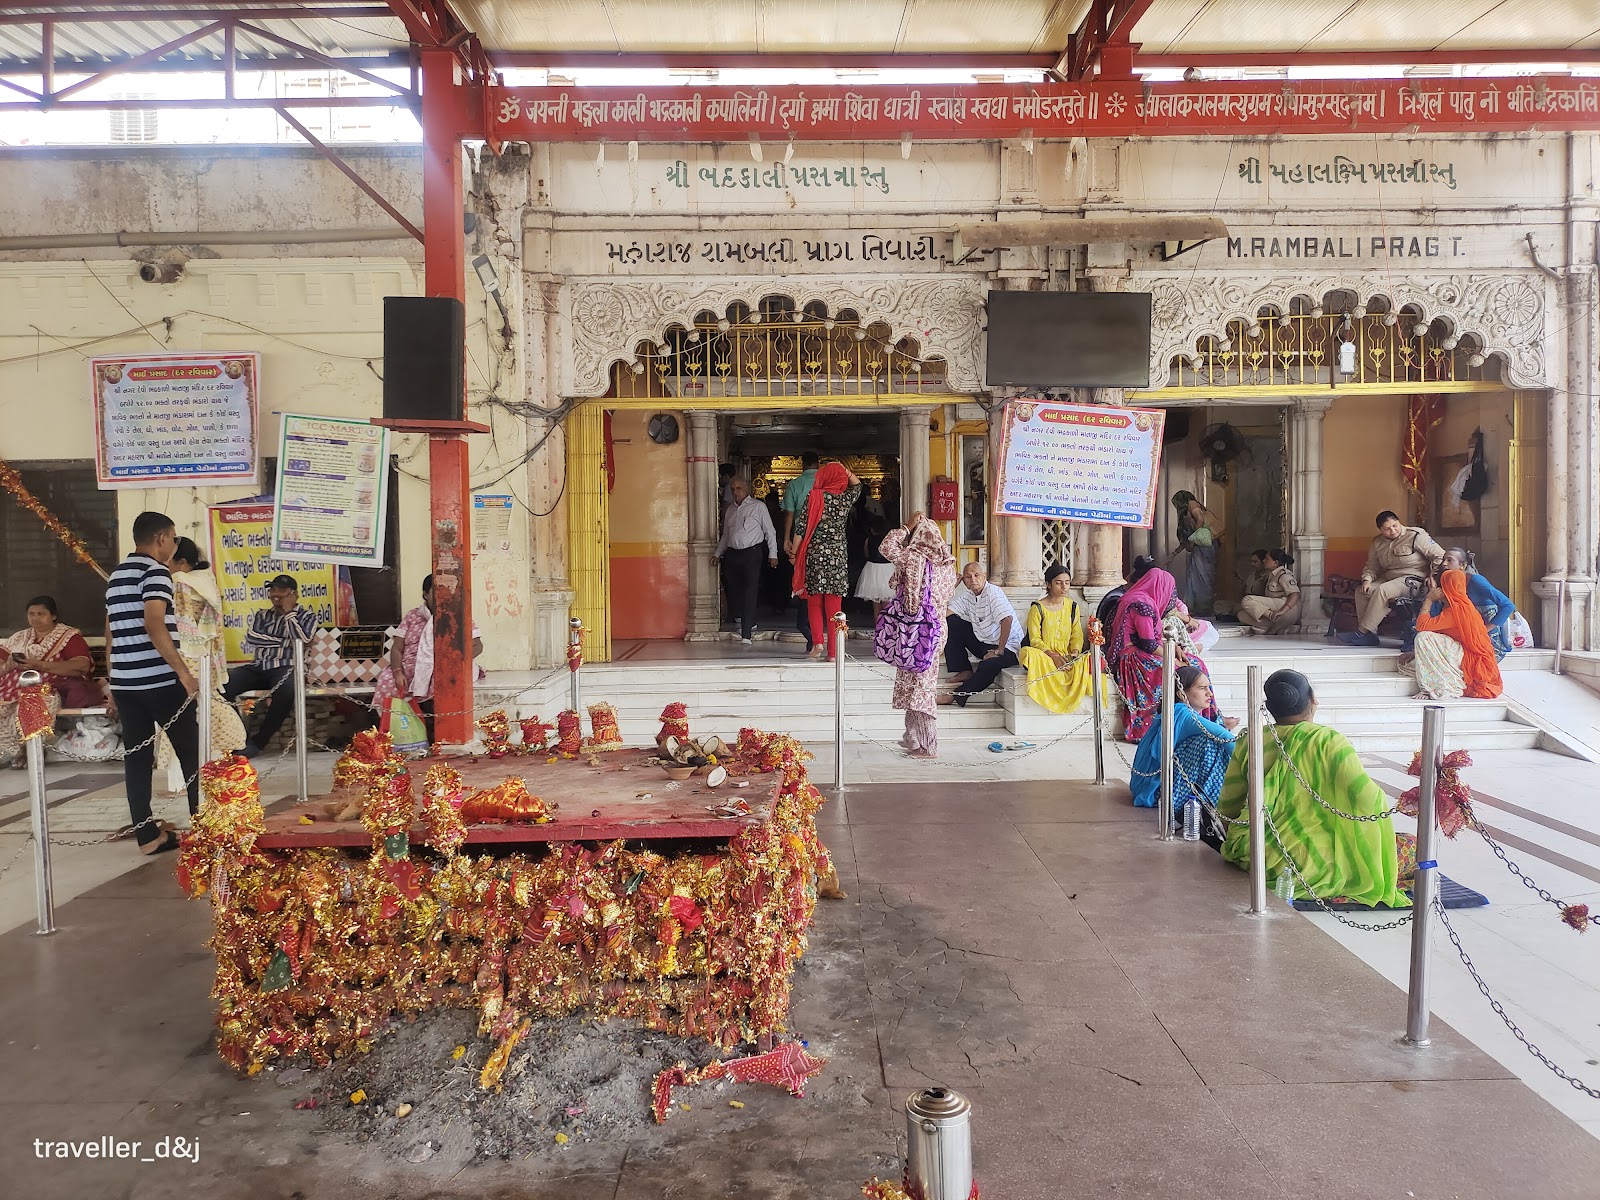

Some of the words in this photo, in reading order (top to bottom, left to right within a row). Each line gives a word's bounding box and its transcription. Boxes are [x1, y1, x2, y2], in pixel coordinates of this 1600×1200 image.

[497, 96, 521, 123] ॐ
[526, 93, 569, 124] जयन्ती
[611, 93, 648, 124] काली
[650, 93, 702, 123] भद्रकाली
[779, 92, 808, 129] दुर्गा
[810, 98, 841, 126] क्षमा
[844, 92, 880, 121] शिवा
[884, 90, 922, 120] धात्री
[927, 97, 966, 125] स्वाहा
[970, 97, 1007, 120] स्वधा
[1448, 91, 1476, 120] पातु
[1480, 83, 1501, 114] नो
[667, 160, 690, 188] શ્રી
[1239, 157, 1262, 184] શ્રી
[605, 241, 692, 264] મહારાજ
[701, 238, 798, 264] રામબલી
[803, 240, 854, 262] પ્રાગ
[1371, 236, 1439, 257] PRAG
[1449, 236, 1466, 257] T.
[330, 424, 364, 435] MART
[222, 528, 244, 548] ભાવિક
[301, 583, 327, 598] સનાતન
